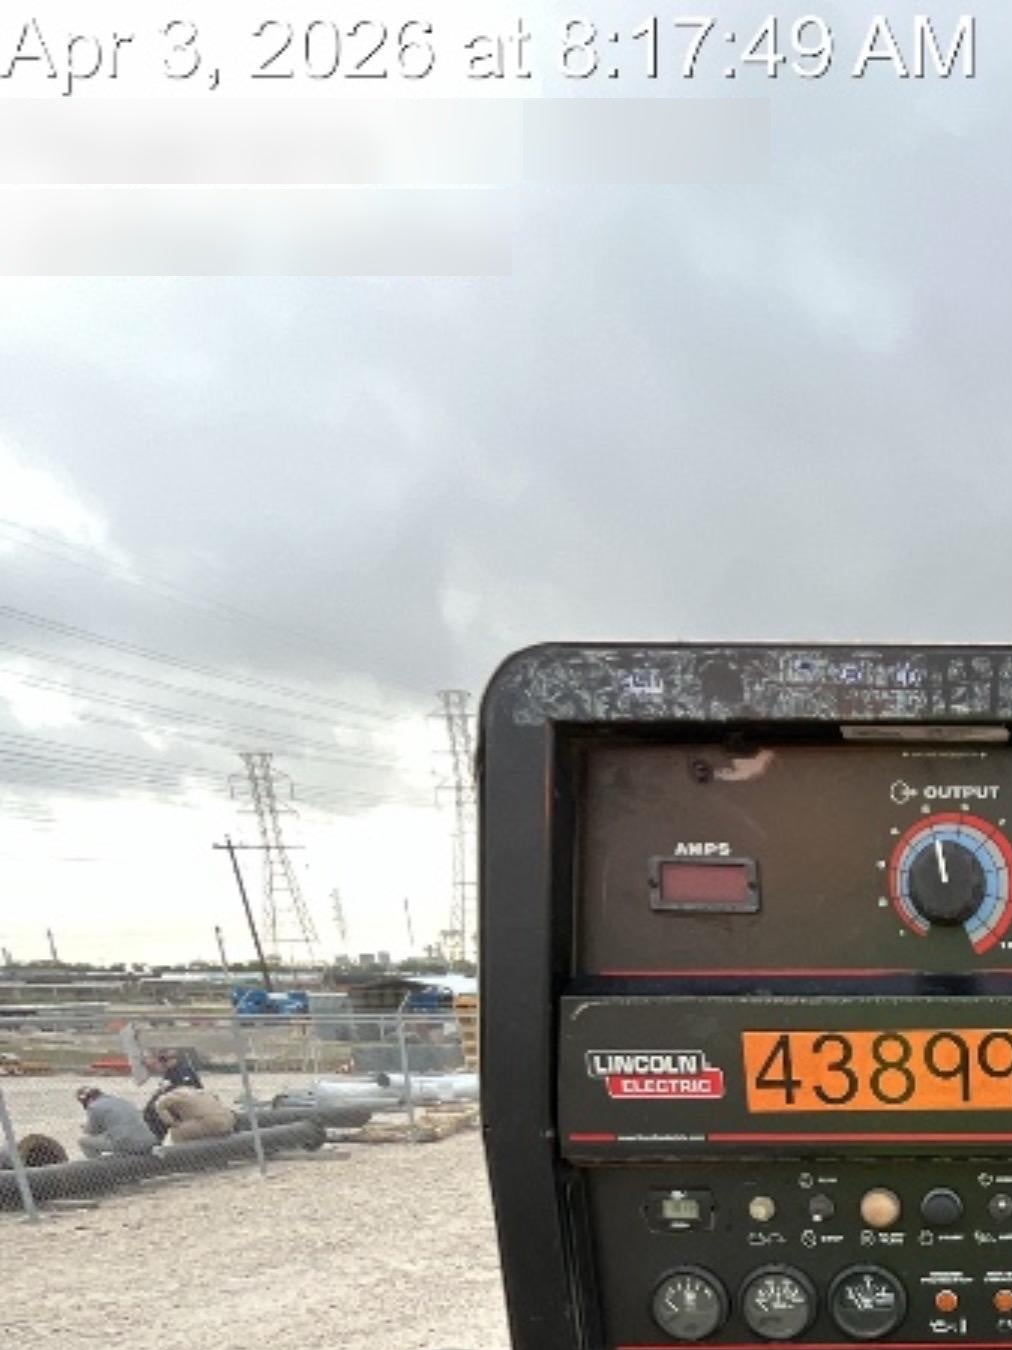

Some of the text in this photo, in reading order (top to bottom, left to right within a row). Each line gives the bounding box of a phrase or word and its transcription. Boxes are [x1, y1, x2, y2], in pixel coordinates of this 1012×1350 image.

[923, 785, 1000, 799] OUTPUT
[674, 843, 731, 856] AMPS
[593, 1055, 697, 1074] LINCOLN
[620, 1079, 712, 1093] ELECTRIC
